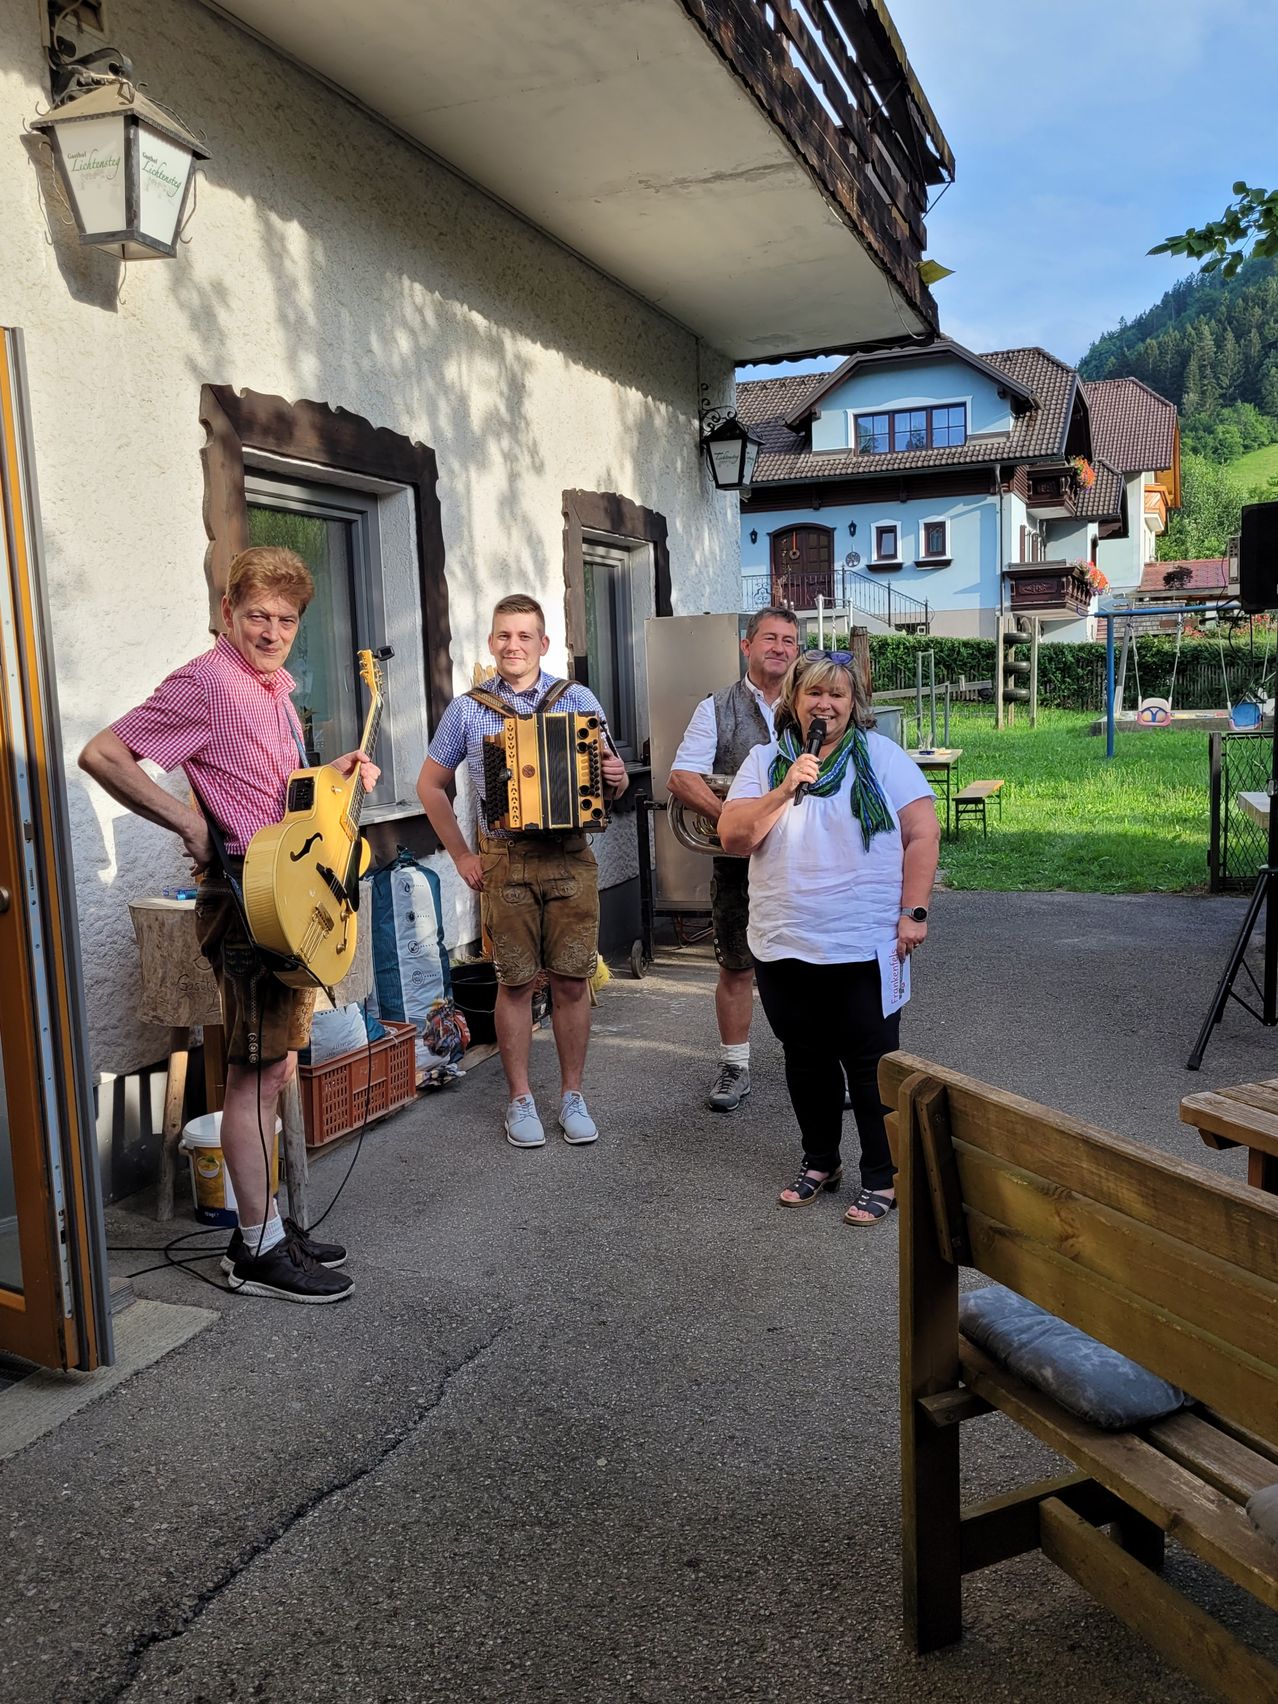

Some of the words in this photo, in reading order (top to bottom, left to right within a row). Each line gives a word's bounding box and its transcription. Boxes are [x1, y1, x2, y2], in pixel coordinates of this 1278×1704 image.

[71, 148, 121, 180] Lichtensteg
[142, 161, 182, 197] Lichtensteg
[889, 948, 899, 1004] Frankenfels
